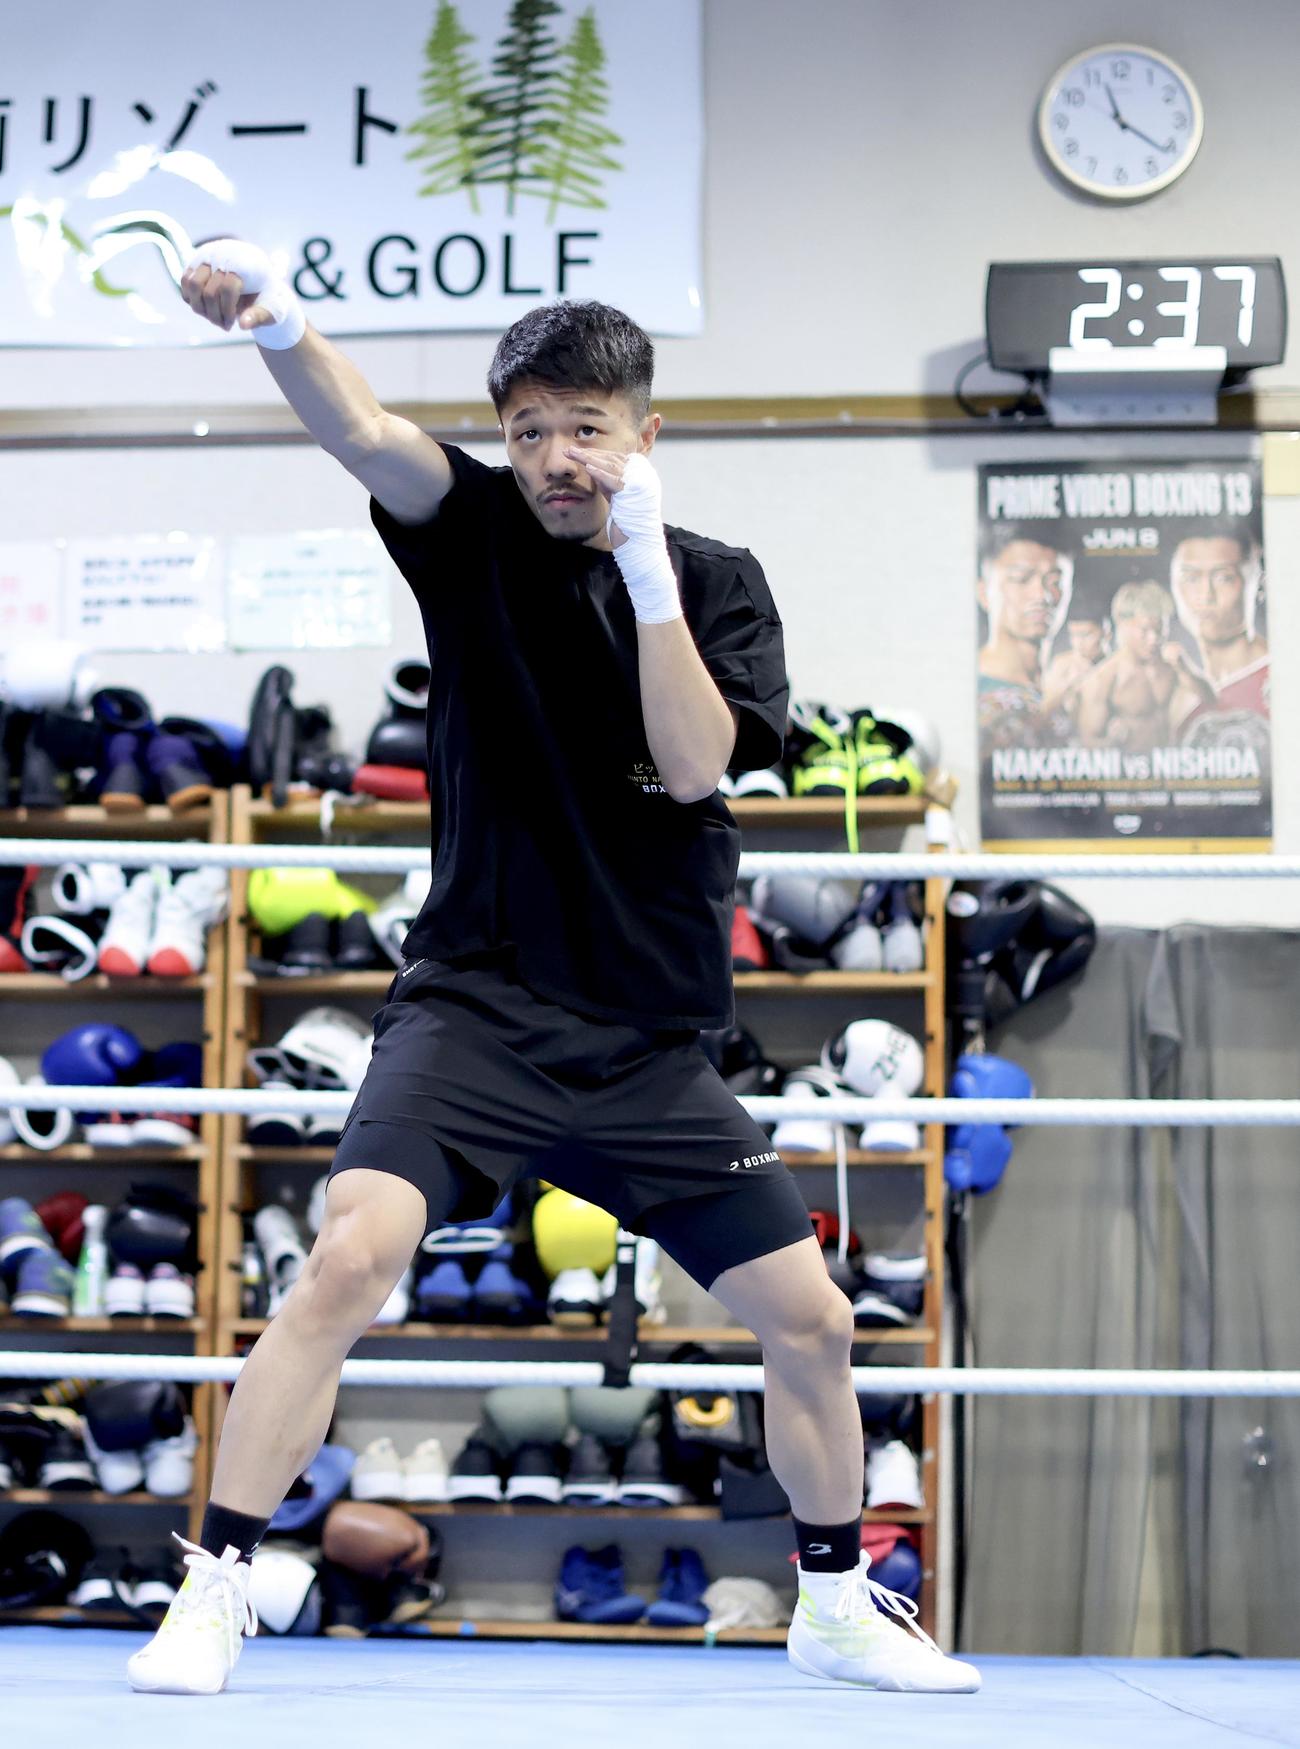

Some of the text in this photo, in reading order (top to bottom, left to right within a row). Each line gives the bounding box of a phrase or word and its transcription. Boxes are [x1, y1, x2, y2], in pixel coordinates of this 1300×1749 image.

[293, 232, 602, 300] & GOLF
[1069, 266, 1256, 351] 2:37
[987, 472, 1252, 519] PRIME VIDEO BOXING 13
[1082, 527, 1137, 549] JUN
[992, 748, 1121, 781] NAKATANI
[1152, 746, 1260, 780] NISHIDA
